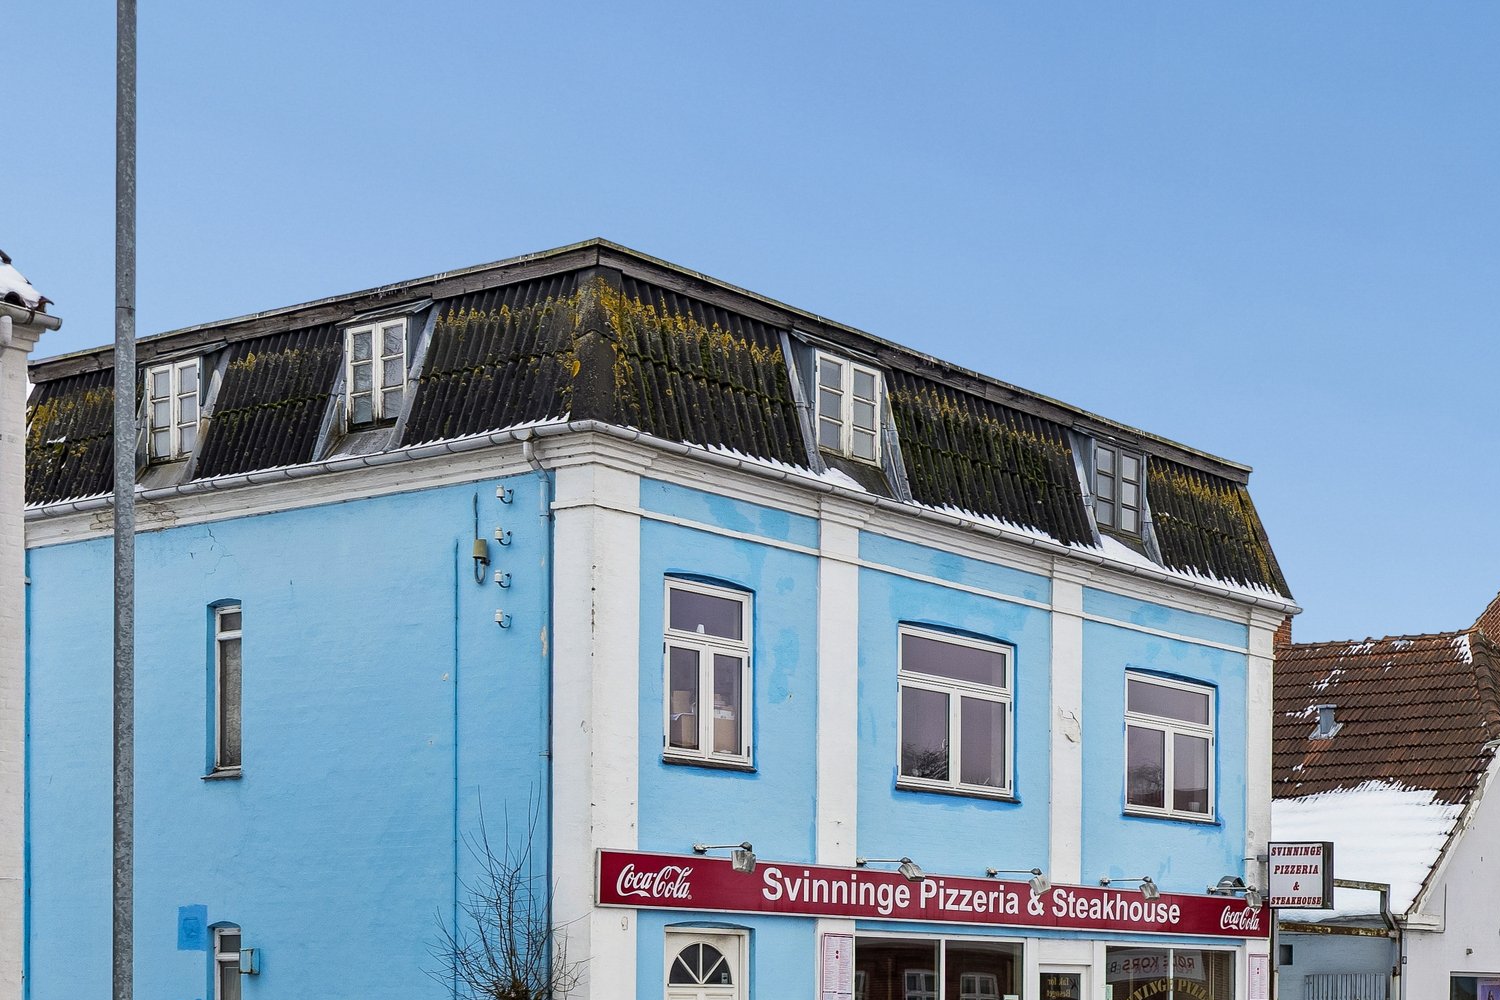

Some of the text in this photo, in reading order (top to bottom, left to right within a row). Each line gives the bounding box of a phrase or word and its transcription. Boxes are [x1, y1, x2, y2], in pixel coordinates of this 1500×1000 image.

[1271, 846, 1322, 857] SVINNINGE
[1273, 864, 1320, 875] PIZZERIA
[616, 863, 693, 899] Coca-Cola
[1292, 881, 1300, 891] &
[762, 867, 1180, 924] Svinninge Pizzeria & Steakhouse
[1271, 896, 1322, 905] STEAKHOUSE
[1220, 904, 1260, 931] Coca-Cola
